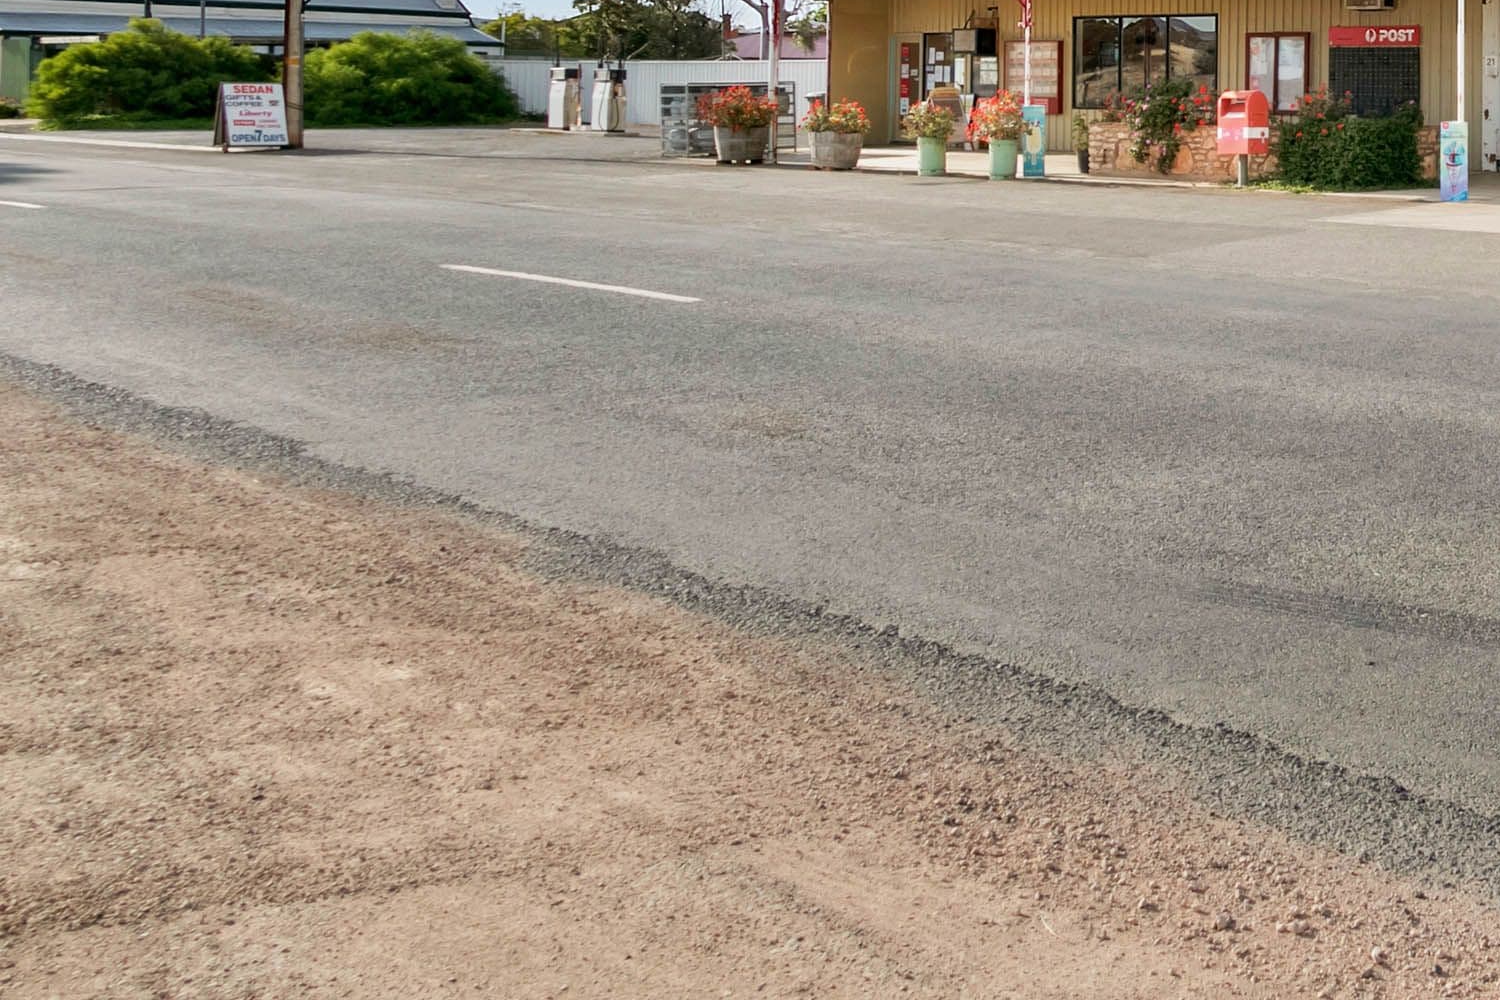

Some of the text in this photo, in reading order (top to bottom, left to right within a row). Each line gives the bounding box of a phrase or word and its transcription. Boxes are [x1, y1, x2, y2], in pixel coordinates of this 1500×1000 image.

[1379, 29, 1415, 42] POST
[1486, 58, 1495, 66] 21
[233, 85, 273, 94] SEDAN
[231, 129, 286, 143] OPEN 7 DAYS
